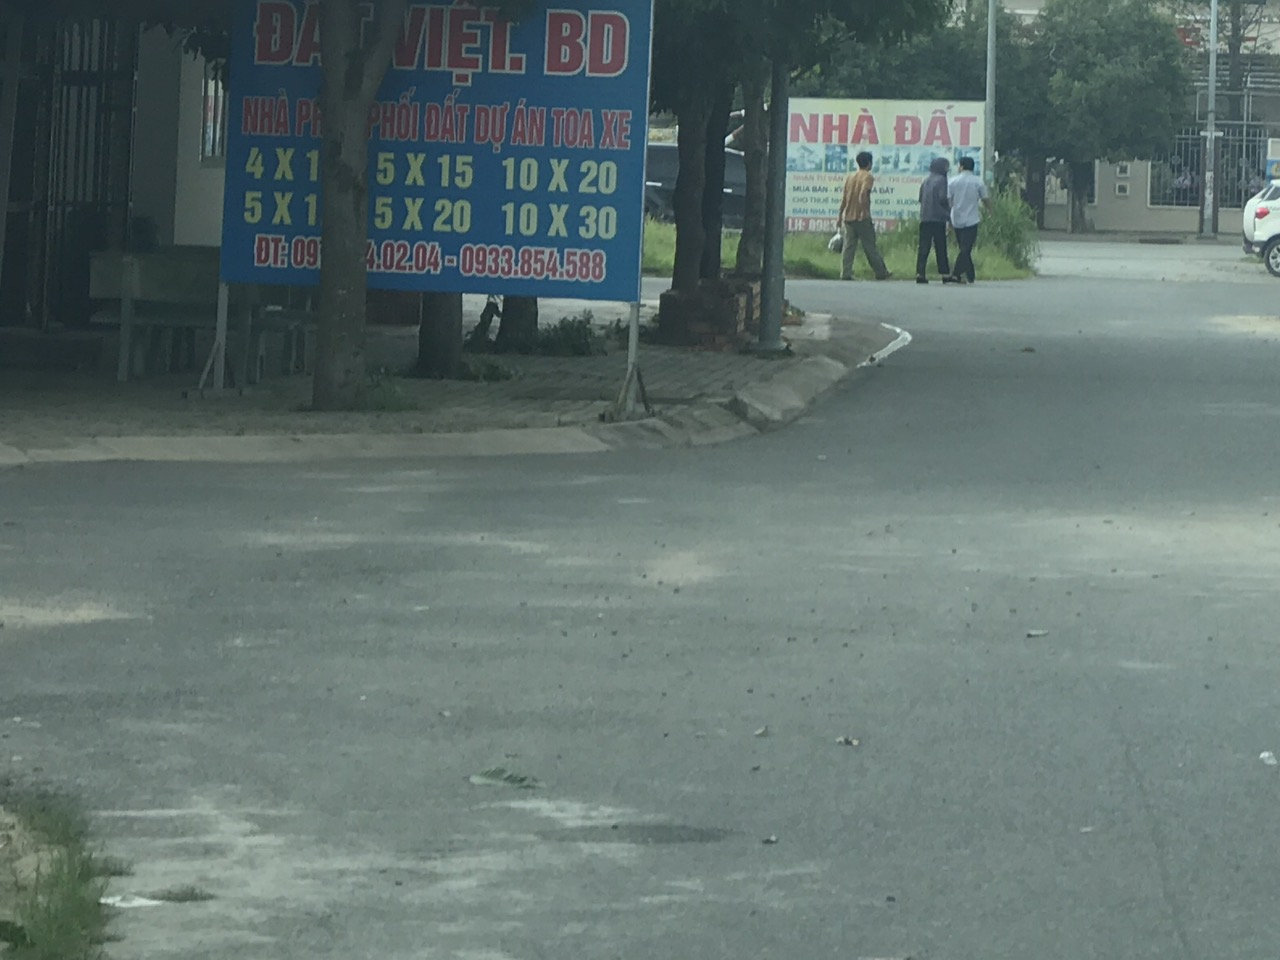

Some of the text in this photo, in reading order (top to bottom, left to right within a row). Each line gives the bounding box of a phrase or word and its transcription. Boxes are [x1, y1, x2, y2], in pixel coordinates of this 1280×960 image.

[544, 8, 630, 78] BD
[241, 89, 290, 137] NHÀ
[425, 89, 470, 143] ĐẤT
[474, 102, 511, 153] DỰ
[512, 98, 546, 146] ÁN
[552, 109, 596, 149] TOA
[599, 109, 632, 150] XE
[790, 104, 978, 146] NHÀ ĐẤT
[245, 147, 264, 180] 4
[376, 152, 395, 186] 5
[438, 155, 473, 189] 15
[502, 157, 538, 192] 10
[578, 159, 618, 195] 20
[243, 191, 262, 224] 5
[374, 197, 393, 230] 5
[433, 199, 471, 233] 20
[502, 202, 538, 236] 10
[578, 205, 618, 240] 30
[253, 235, 287, 268] ĐT:
[459, 245, 607, 284] 0933.854.588
